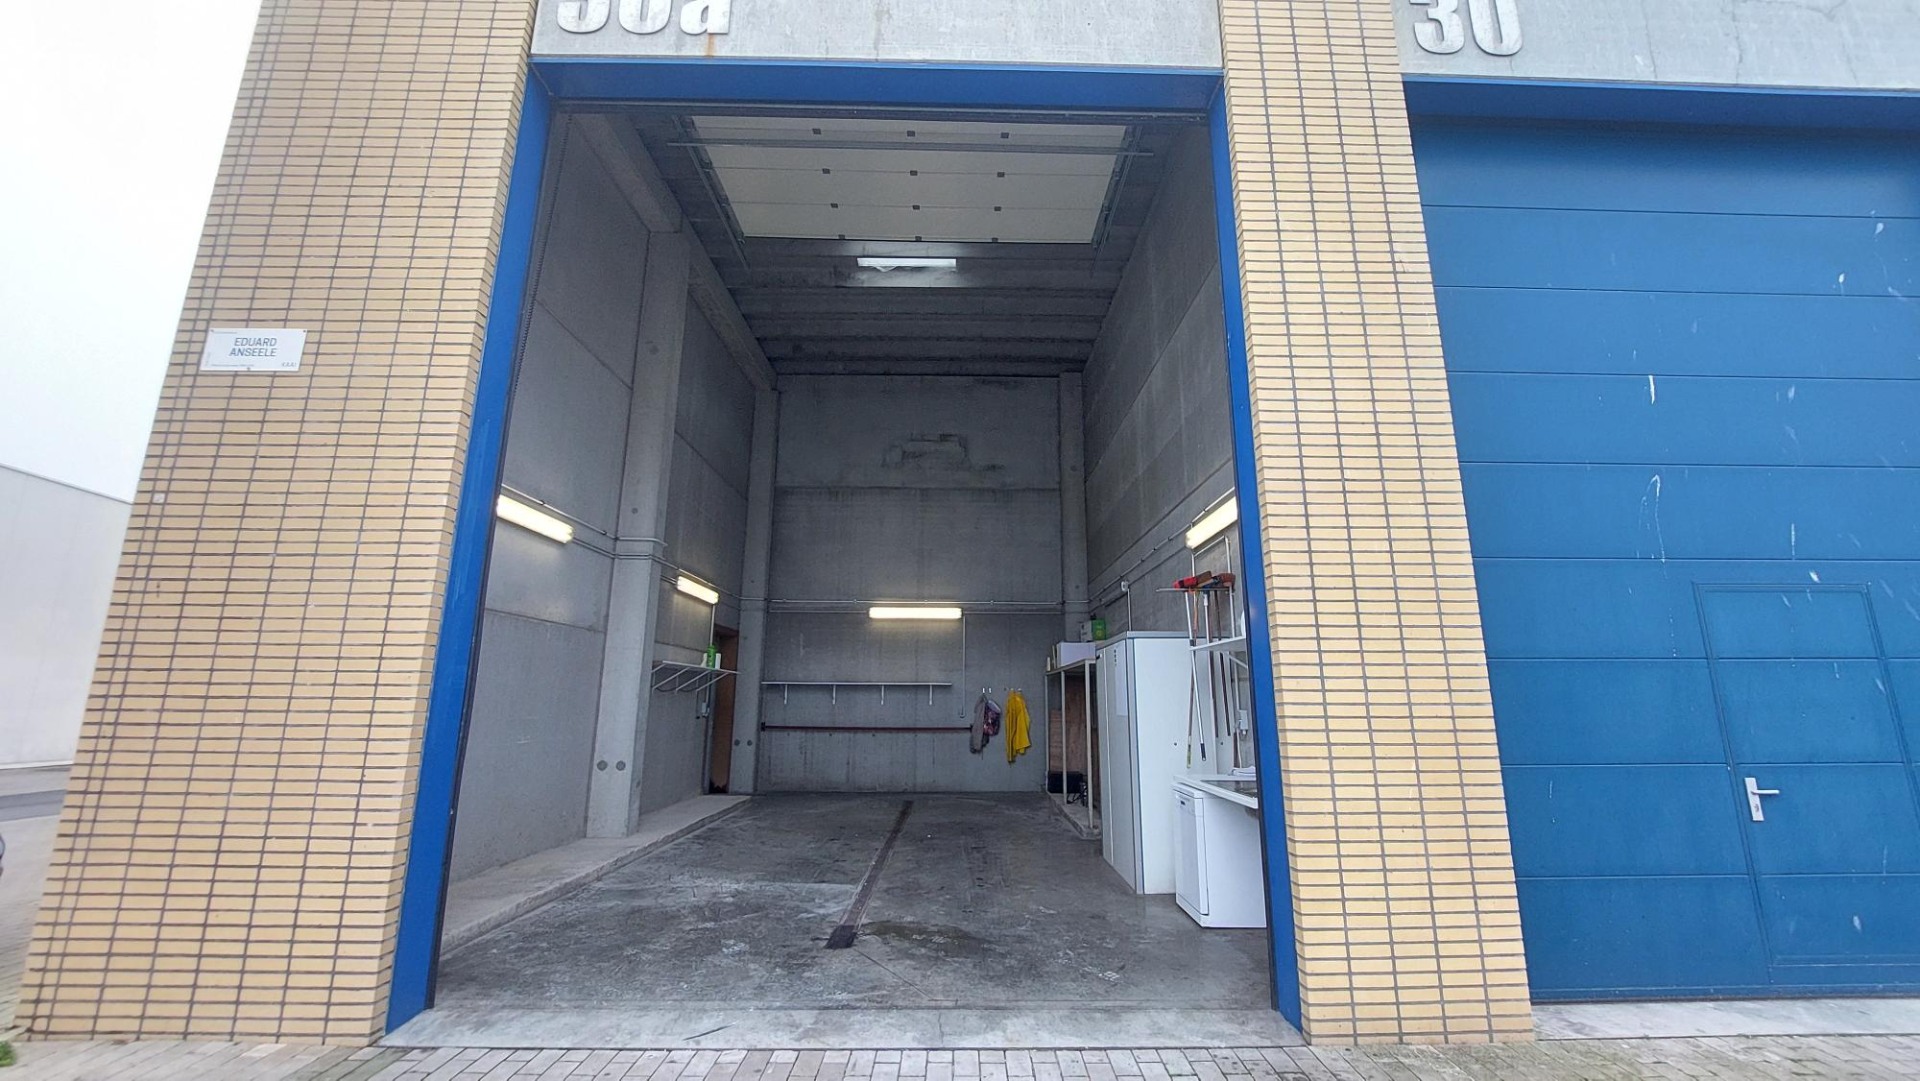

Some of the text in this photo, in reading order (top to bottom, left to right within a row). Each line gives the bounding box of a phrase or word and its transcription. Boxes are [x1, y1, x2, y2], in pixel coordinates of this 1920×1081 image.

[1408, 0, 1523, 57] 30
[234, 337, 278, 347] EDUARD
[229, 347, 278, 357] ANSEELE
